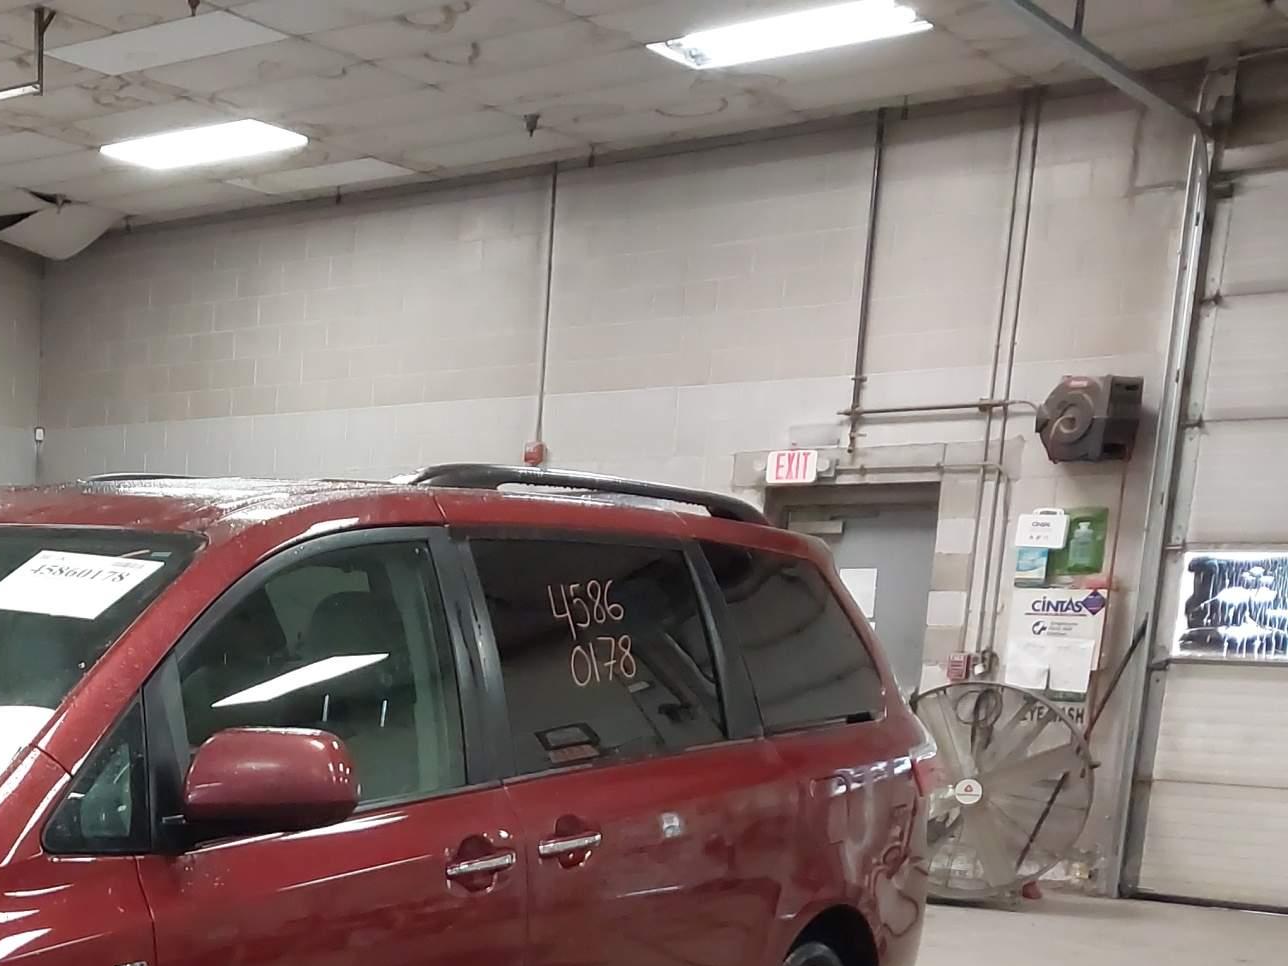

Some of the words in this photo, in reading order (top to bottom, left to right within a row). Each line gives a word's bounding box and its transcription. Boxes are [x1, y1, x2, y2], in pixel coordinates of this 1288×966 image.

[776, 452, 811, 480] EXIT
[31, 564, 130, 582] 45860178
[548, 580, 624, 640] 4586
[571, 635, 636, 687] 0178
